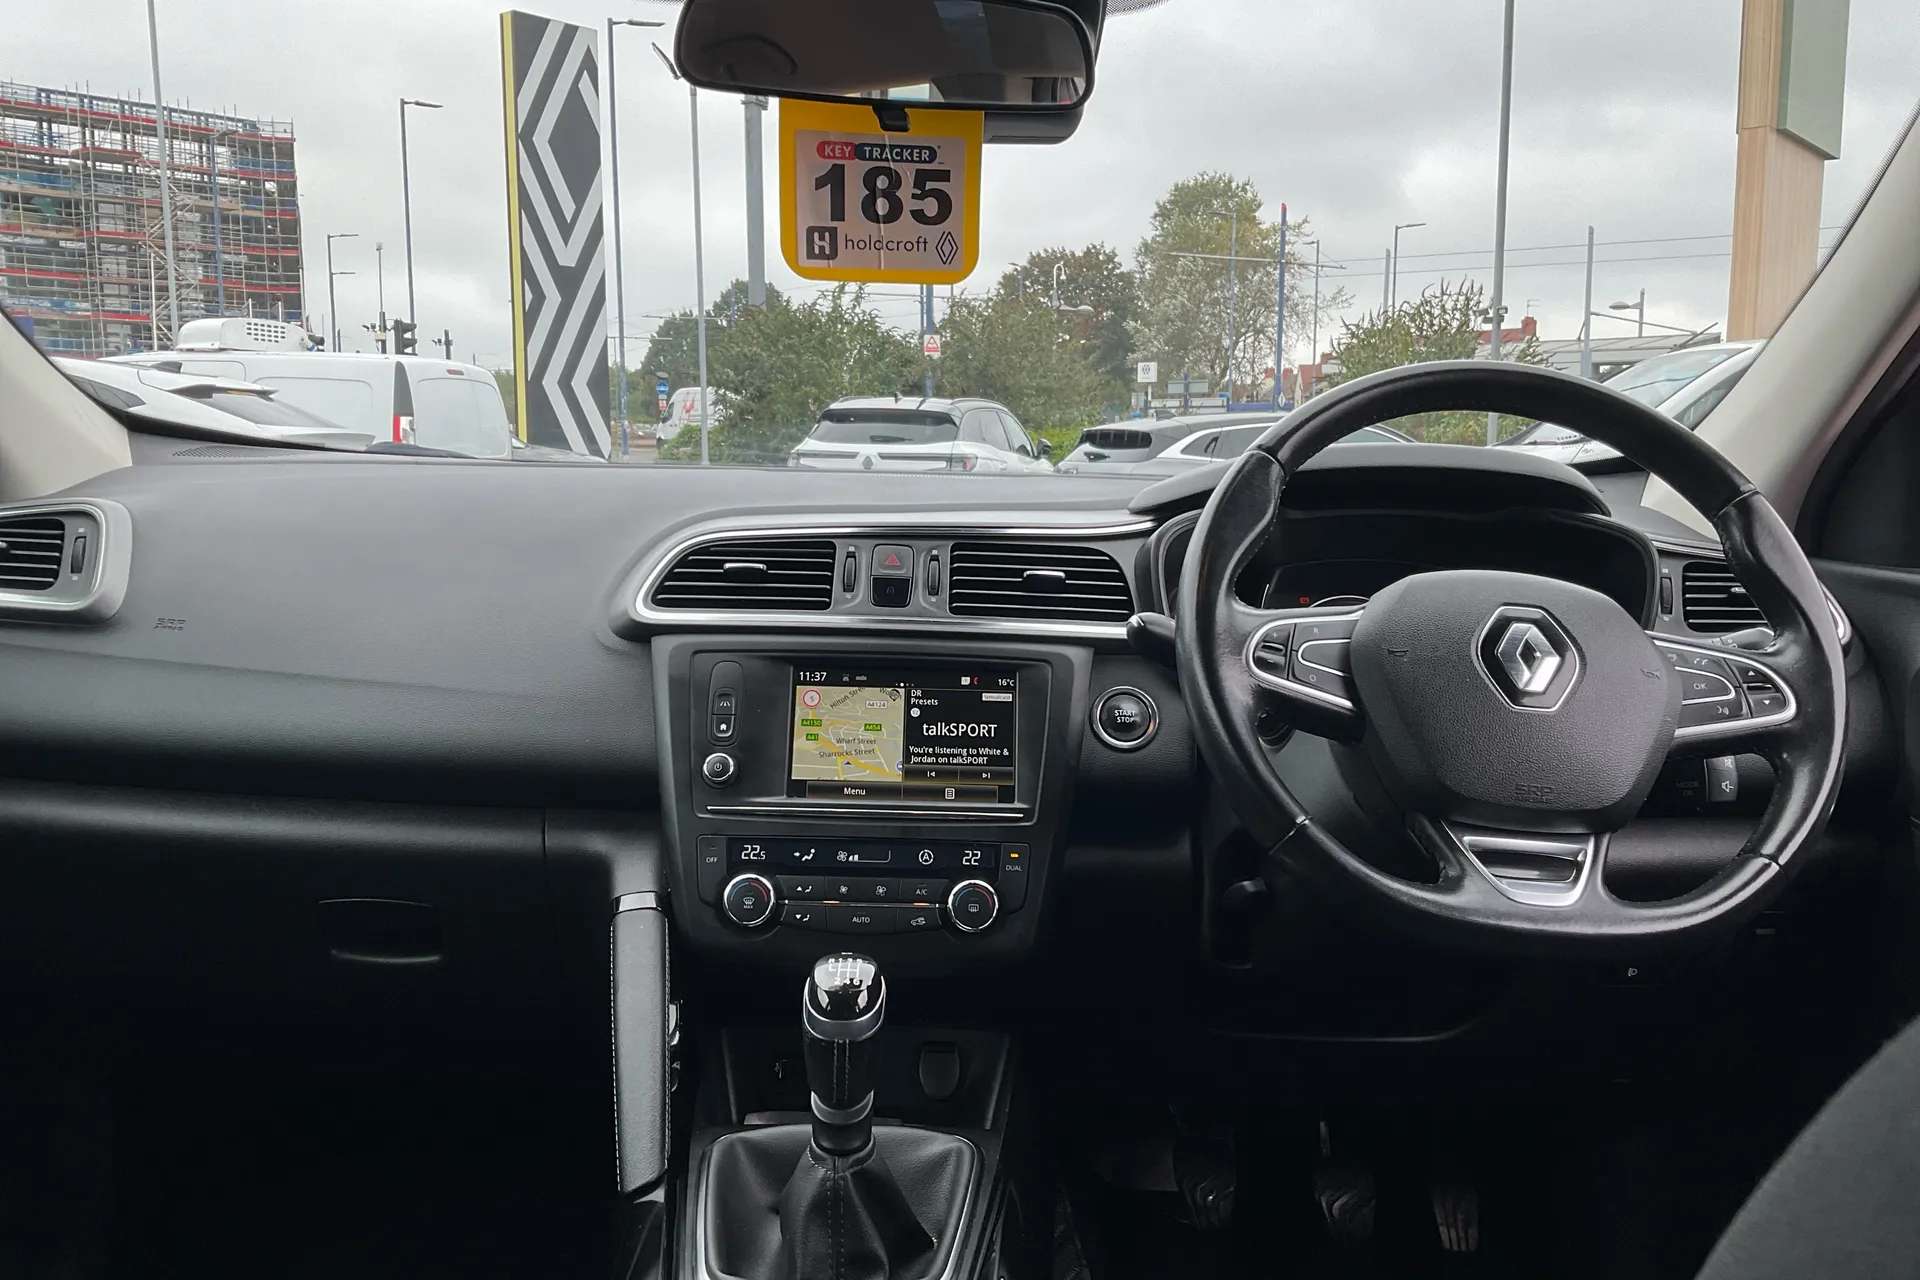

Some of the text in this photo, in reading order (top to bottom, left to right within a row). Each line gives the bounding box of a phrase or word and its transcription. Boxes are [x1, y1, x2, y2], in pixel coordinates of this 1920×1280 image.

[824, 143, 930, 162] KEY TRACKER
[814, 163, 953, 226] 185
[844, 233, 928, 253] holdcroft
[799, 671, 827, 682] 11:37
[1692, 682, 1707, 690] OK
[911, 689, 922, 697] DR
[910, 697, 939, 706] Presets
[1114, 709, 1136, 717] START
[922, 721, 998, 738] talkSPORT
[908, 745, 1010, 757] You're listening to White &
[910, 755, 936, 764] Jordan
[950, 756, 988, 765] talkSPORT
[843, 787, 866, 796] Menu
[741, 844, 766, 860] 22.5
[962, 850, 981, 866] 22
[1005, 864, 1023, 872] DUAL
[915, 888, 928, 896] A/C
[852, 916, 871, 924] AUTO
